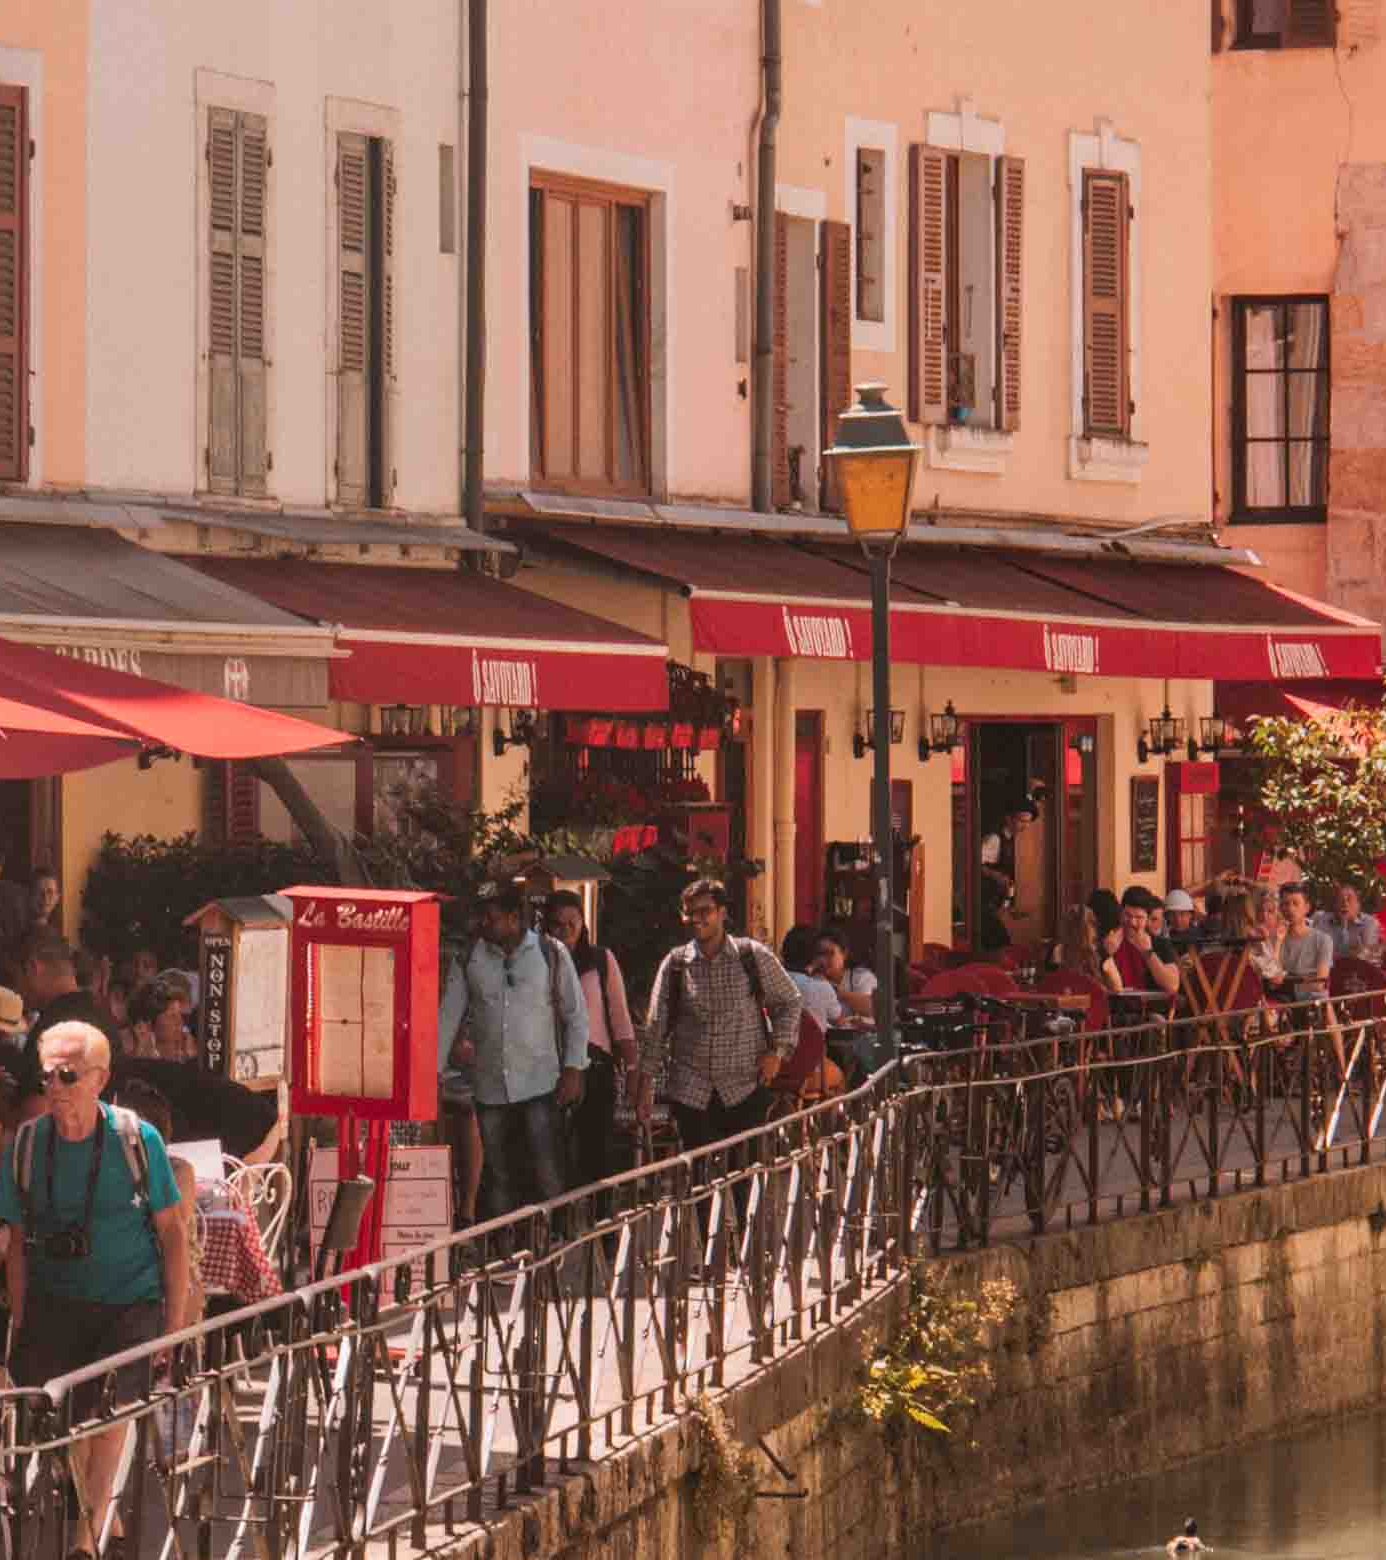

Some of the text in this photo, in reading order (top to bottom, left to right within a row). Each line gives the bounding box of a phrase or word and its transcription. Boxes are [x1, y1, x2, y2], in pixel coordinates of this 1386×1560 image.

[481, 659, 532, 705] SAVOYARD
[297, 901, 411, 931] La Bastille
